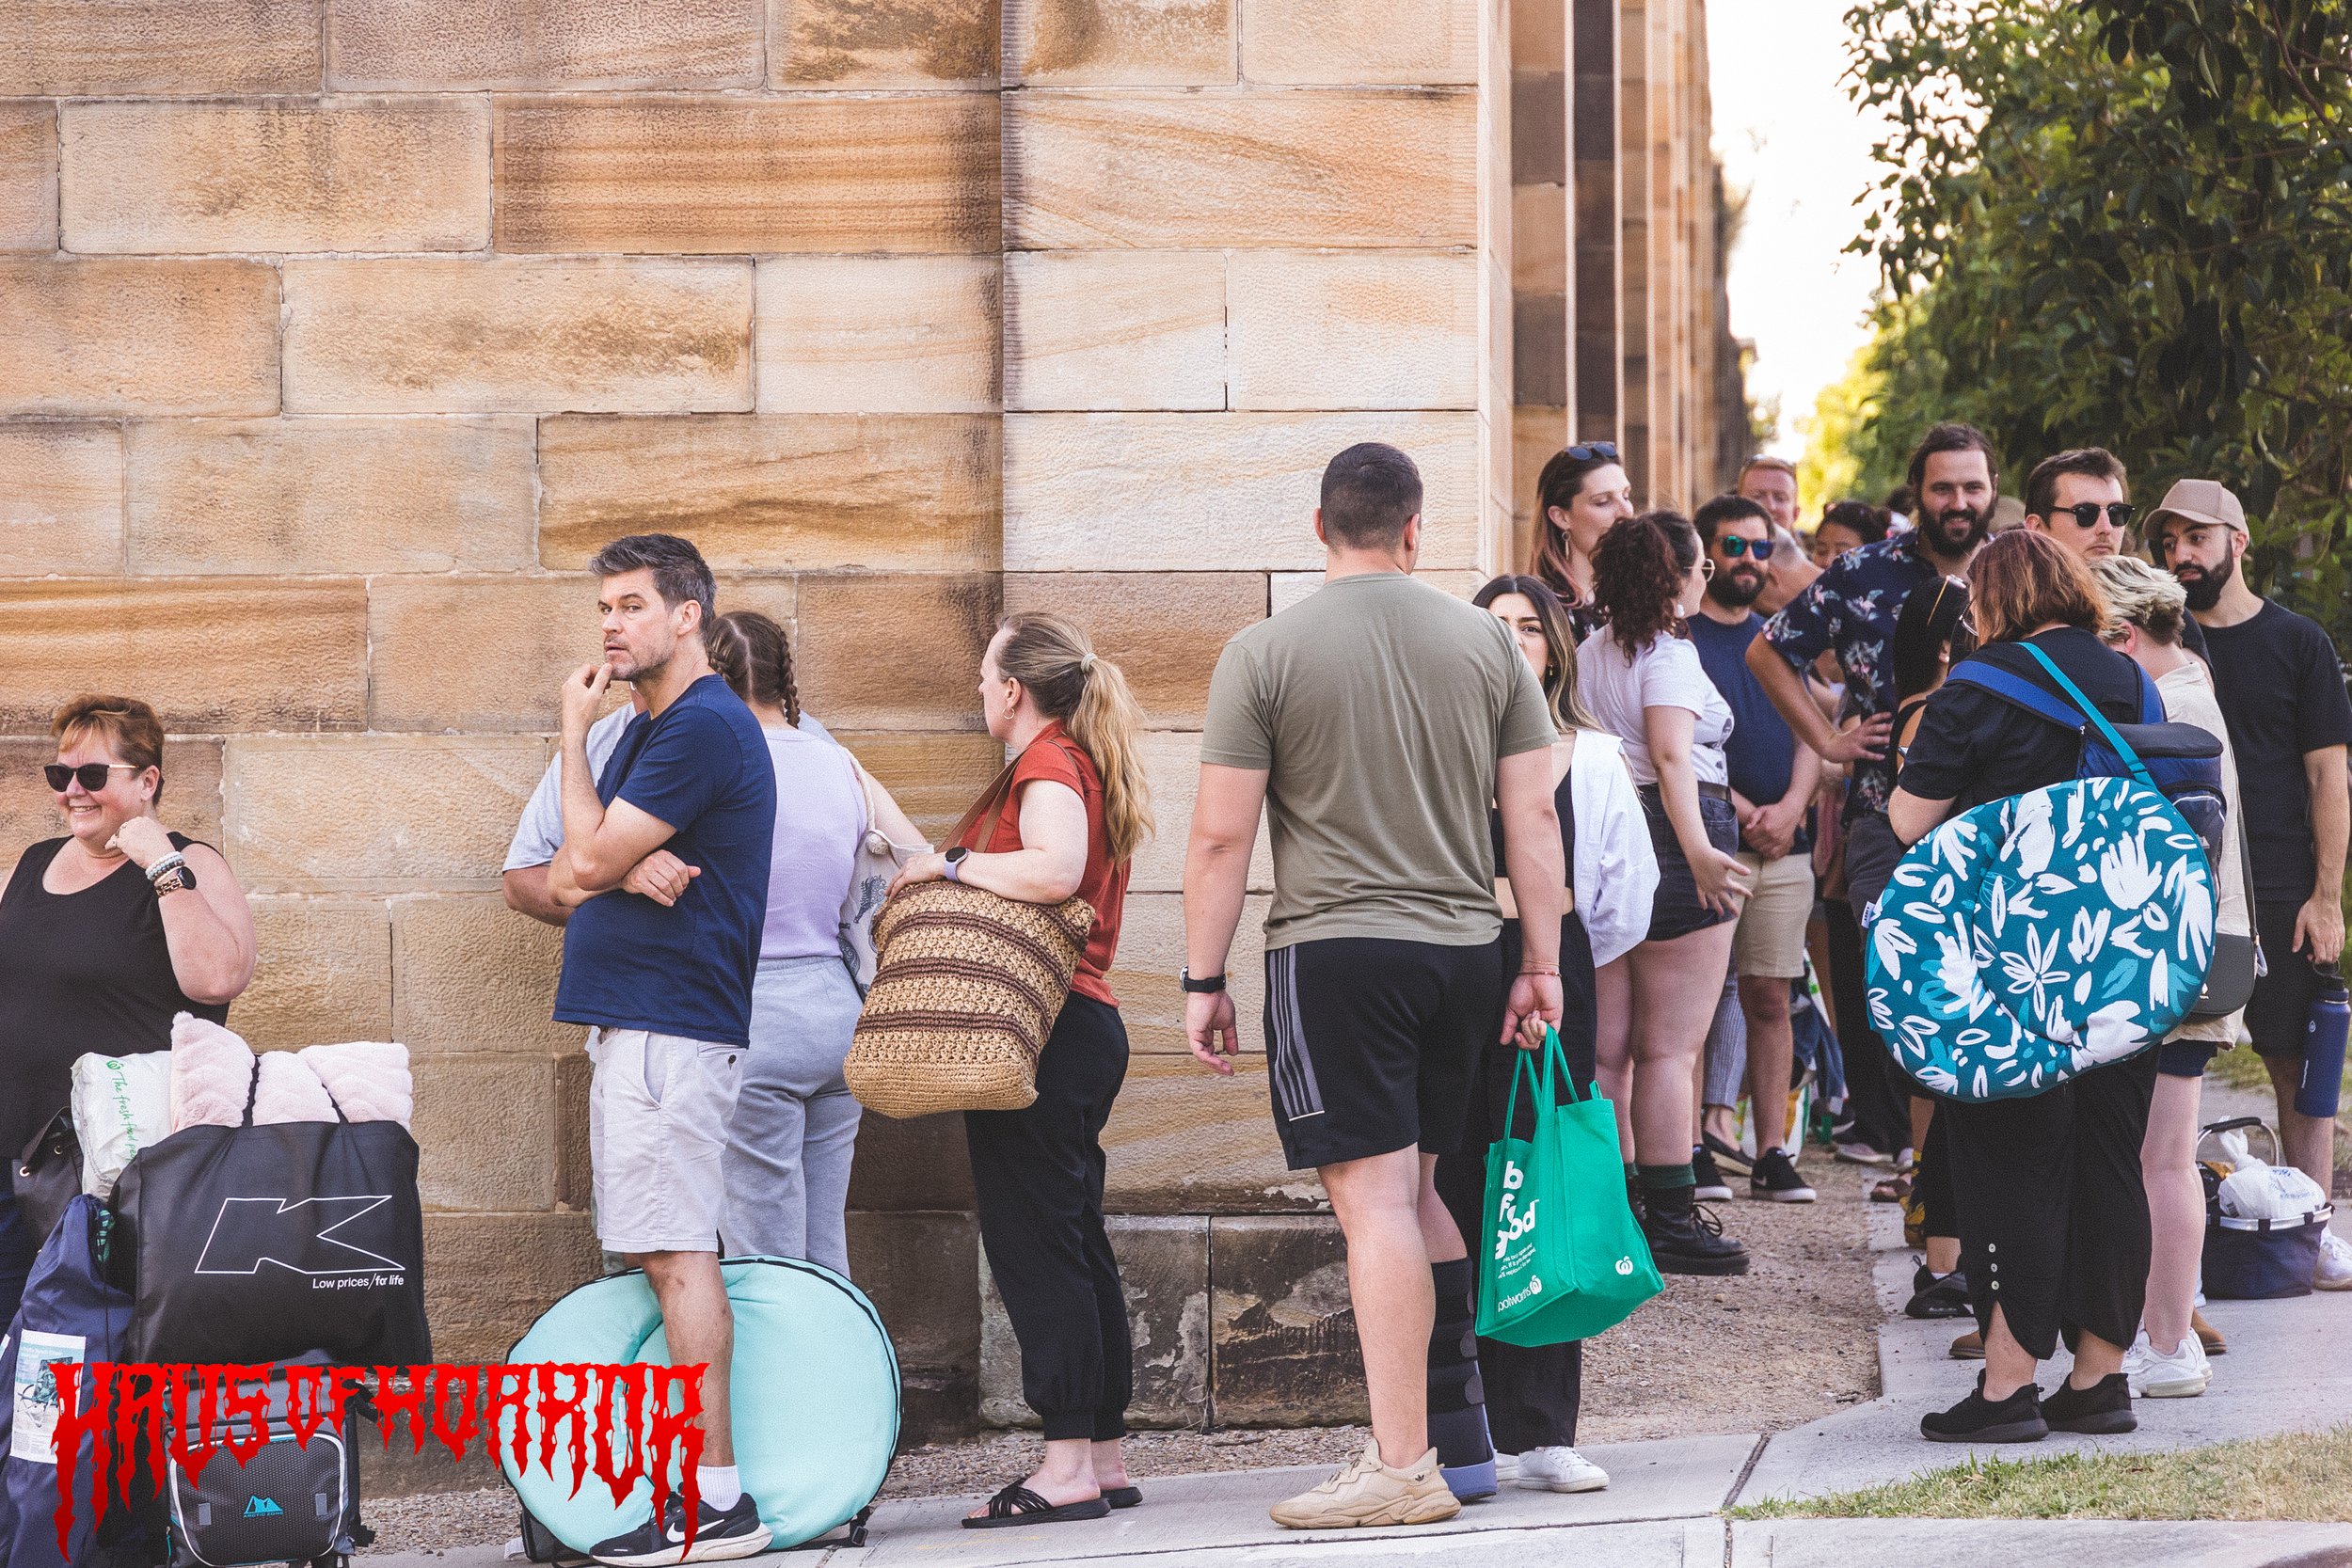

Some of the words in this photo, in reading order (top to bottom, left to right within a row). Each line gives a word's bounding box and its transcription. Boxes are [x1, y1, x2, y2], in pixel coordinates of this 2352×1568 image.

[112, 1071, 128, 1093] The
[112, 1095, 134, 1120] fresh
[120, 1121, 138, 1142] food
[312, 1277, 335, 1289] Low
[389, 1275, 405, 1286] life
